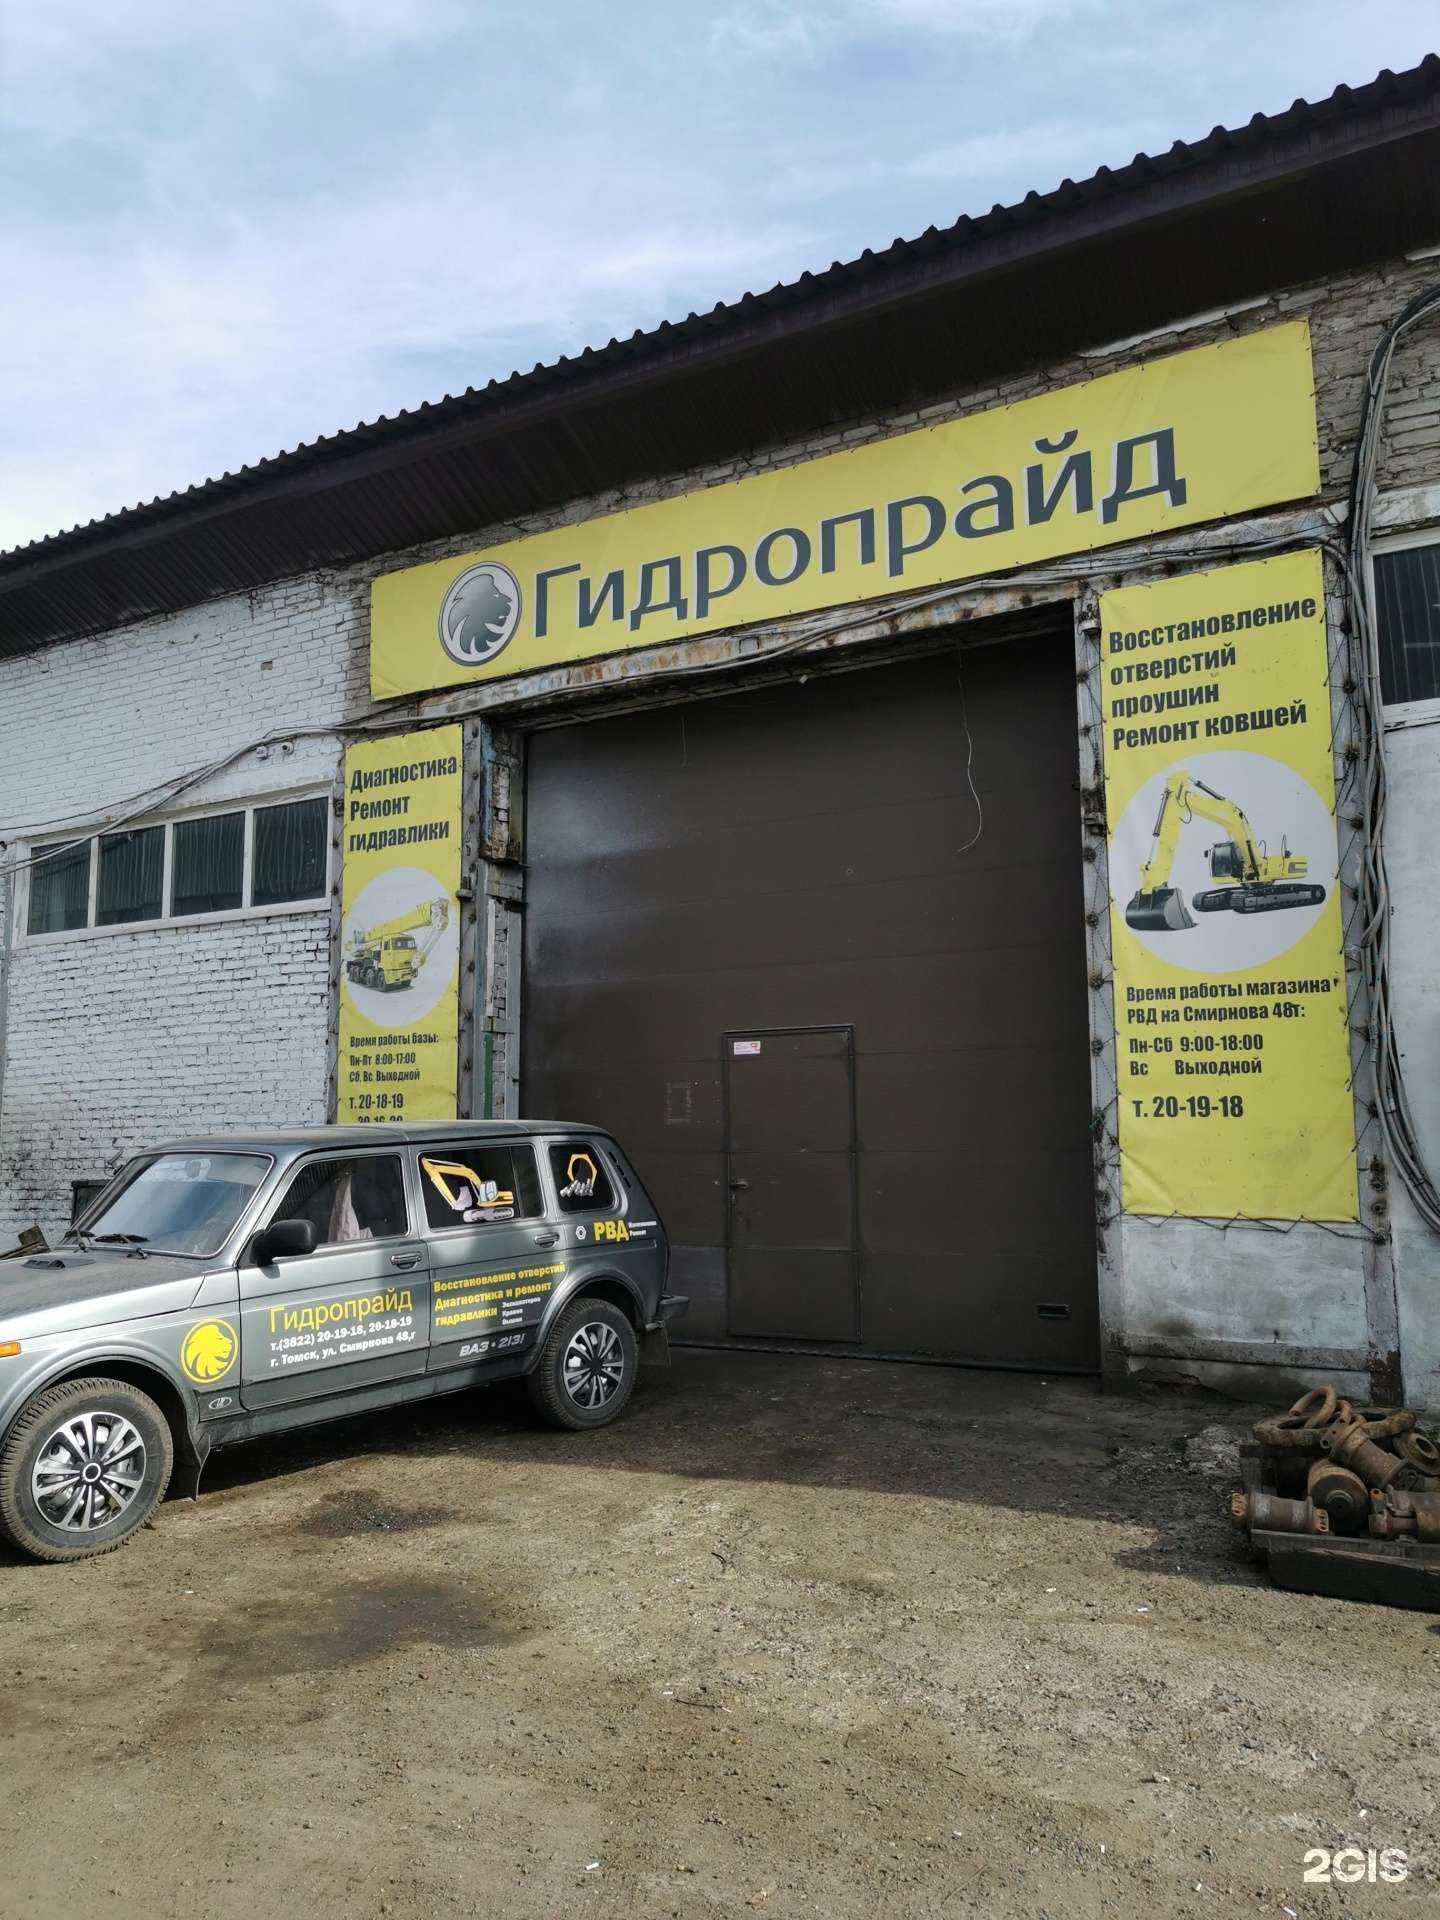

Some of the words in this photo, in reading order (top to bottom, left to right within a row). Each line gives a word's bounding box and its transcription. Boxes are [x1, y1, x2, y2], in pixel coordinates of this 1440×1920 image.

[535, 427, 1187, 639] Гидропрайд
[1109, 597, 1317, 653] Восстановление
[1110, 642, 1236, 685] отверстий
[1111, 684, 1219, 718] проушин
[1113, 719, 1199, 750] Ремонт
[1205, 699, 1307, 738] ковшей
[350, 756, 457, 794] Диагностика
[350, 796, 410, 821] Ремонт
[349, 821, 449, 853] гидравлики
[1127, 986, 1176, 1002] Время
[1180, 982, 1242, 1001] работы
[1246, 979, 1331, 996] магазина
[1127, 1007, 1157, 1025] РВД
[1161, 1010, 1180, 1022] на
[1183, 1004, 1269, 1022] Смирнова
[350, 1036, 376, 1048] Время
[378, 1034, 410, 1047] работы
[412, 1032, 439, 1045] базы:
[1129, 1037, 1173, 1053] Пн-Сб
[1180, 1034, 1264, 1052] 9:00-18:00
[350, 1054, 372, 1066] Пн-Пт
[375, 1052, 416, 1065] 8:00-17:00
[1130, 1061, 1148, 1076] Вс
[1175, 1056, 1262, 1076] Выходной
[363, 1071, 373, 1082] Вс
[376, 1068, 421, 1083] Выходной
[359, 1093, 404, 1109] 20-18-19
[1152, 1095, 1244, 1118] 20-19-18
[593, 1220, 630, 1242] РВД
[434, 1273, 516, 1293] Восстановление
[518, 1262, 566, 1278] отверстий
[434, 1290, 504, 1312] Диагностика
[506, 1288, 513, 1298] и
[515, 1282, 552, 1298] ремонт
[269, 1287, 413, 1332] Гидропрайд
[435, 1307, 498, 1327] гидравлики
[317, 1325, 367, 1343] 20-19-18,
[281, 1350, 320, 1365] Томск,
[322, 1348, 337, 1359] ул.
[339, 1336, 394, 1354] Смирнова
[459, 1340, 490, 1357] ВАЗ
